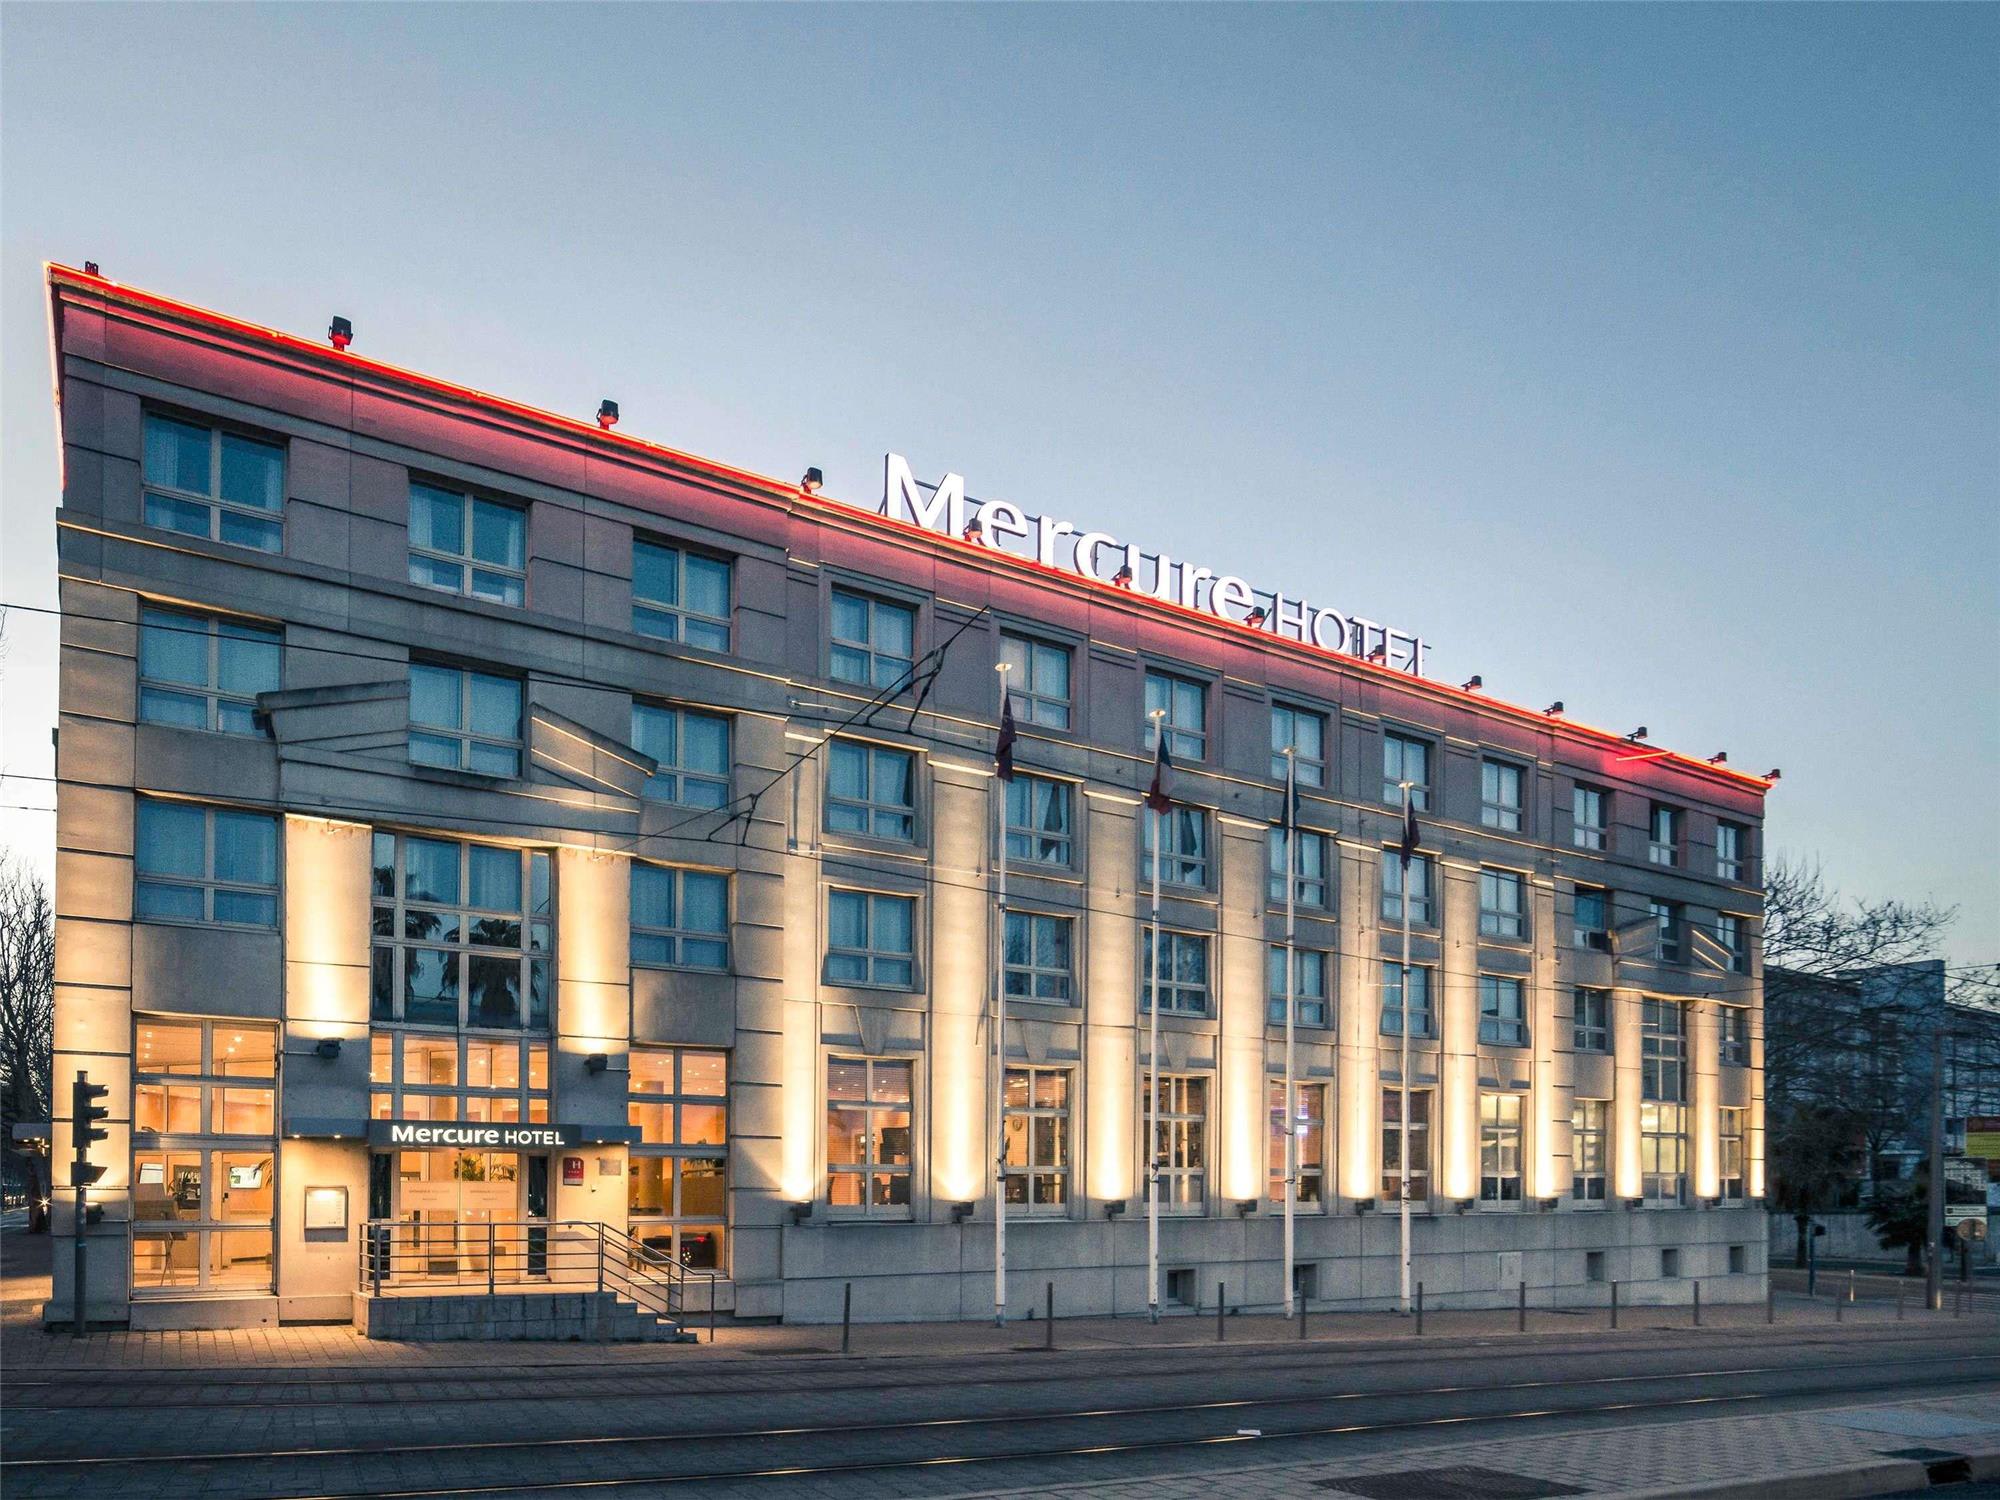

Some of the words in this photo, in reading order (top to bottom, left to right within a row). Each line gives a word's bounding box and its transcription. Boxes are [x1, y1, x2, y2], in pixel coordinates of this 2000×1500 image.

[884, 451, 1255, 624] Mercure
[391, 1125, 500, 1144] Mercure
[504, 1130, 566, 1145] HOTEL
[572, 1160, 581, 1169] H
